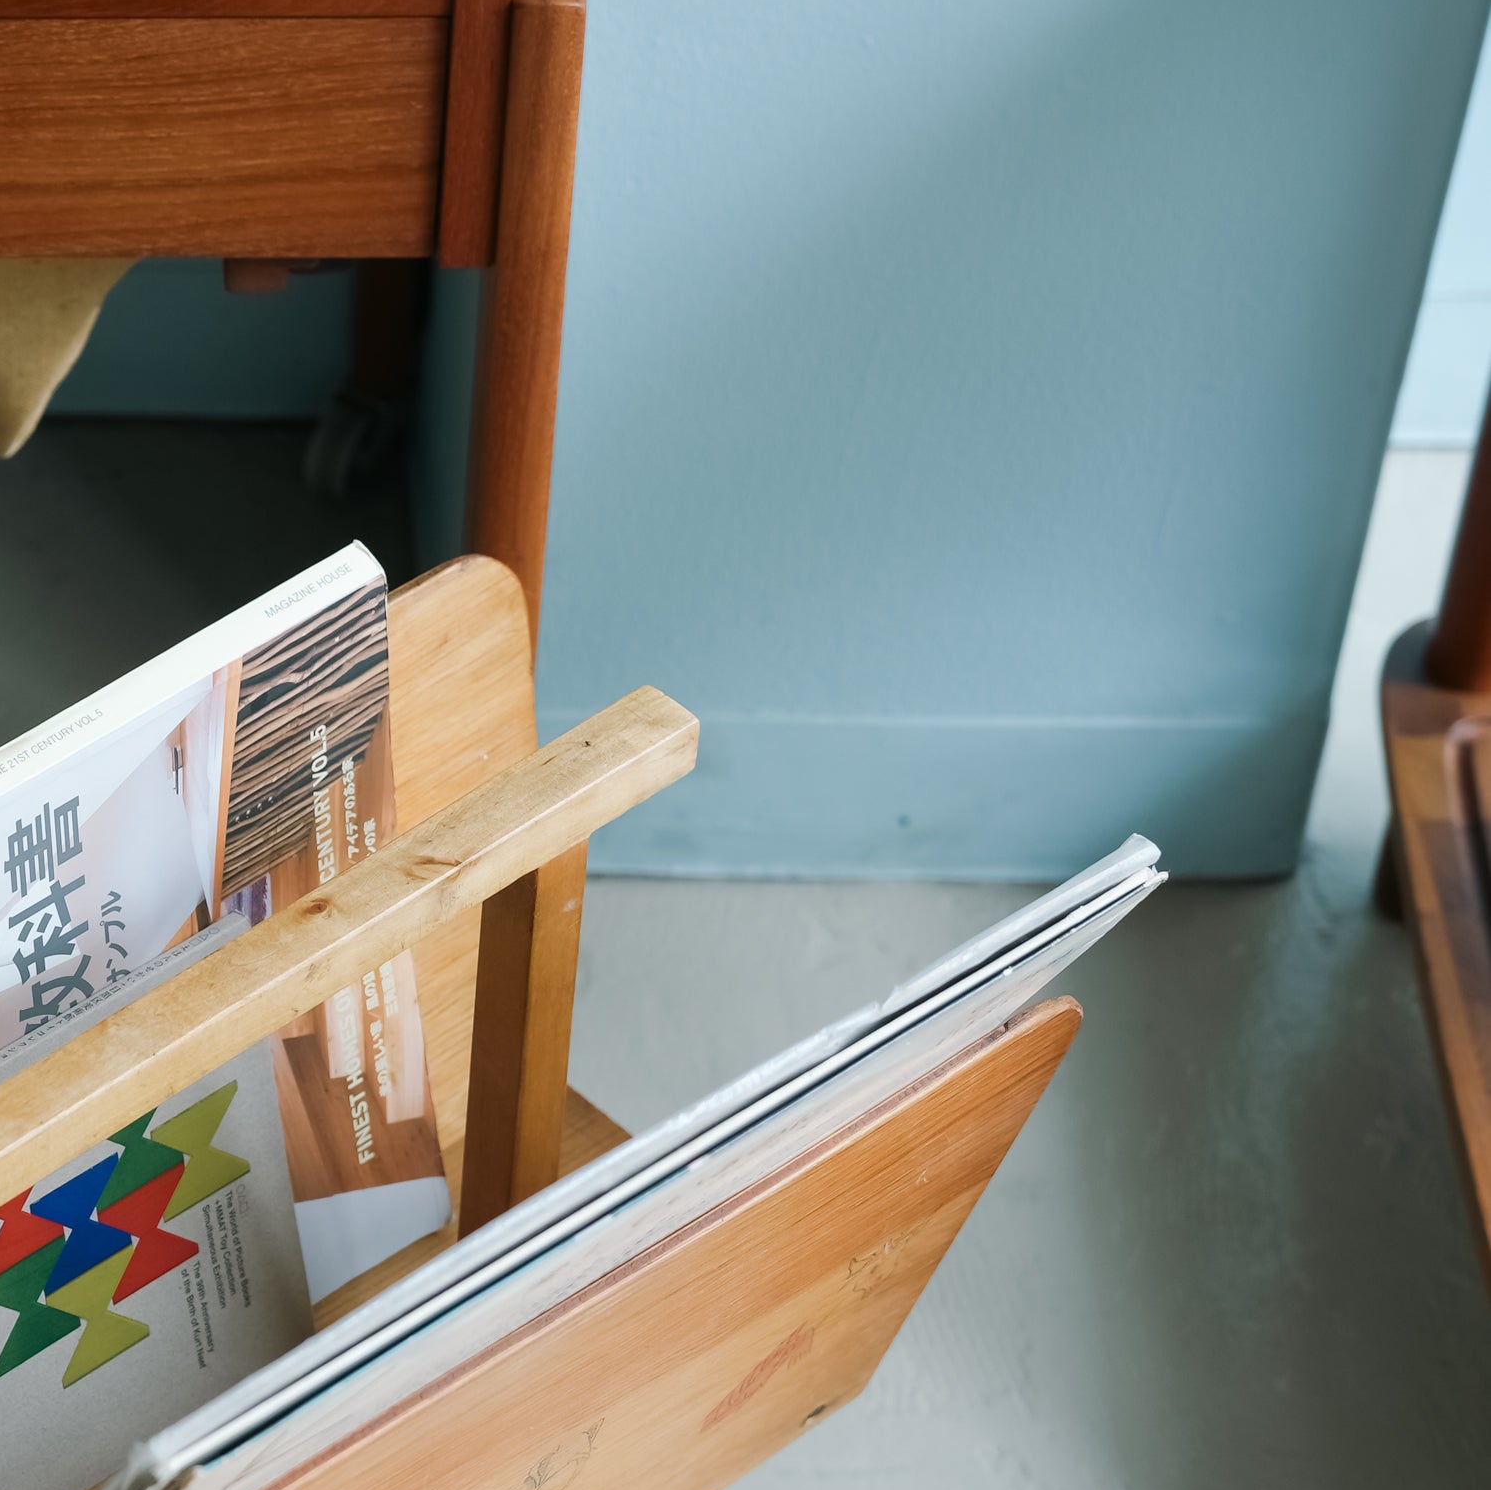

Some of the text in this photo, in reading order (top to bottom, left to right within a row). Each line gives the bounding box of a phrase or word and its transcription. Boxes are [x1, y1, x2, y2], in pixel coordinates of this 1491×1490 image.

[264, 562, 353, 619] MAGAZINE HOUSE
[7, 750, 31, 768] 21ST
[30, 725, 75, 755] CENTURY
[74, 708, 104, 729] VOL.5
[310, 724, 328, 787] VOL.5
[339, 1014, 365, 1089] HOMES
[349, 1089, 375, 1165] FINEST
[225, 1190, 234, 1208] The
[228, 1209, 239, 1232] World
[202, 1204, 227, 1309] Simultaneous Exhibition
[220, 1231, 229, 1250] Toy
[235, 1244, 246, 1273] Picture
[182, 1279, 191, 1295] the
[223, 1252, 236, 1296] Collection
[241, 1274, 252, 1308] Books
[186, 1295, 195, 1316] Birth
[193, 1260, 201, 1279] The
[200, 1302, 214, 1352] Anniversary
[192, 1328, 202, 1349] Kurt
